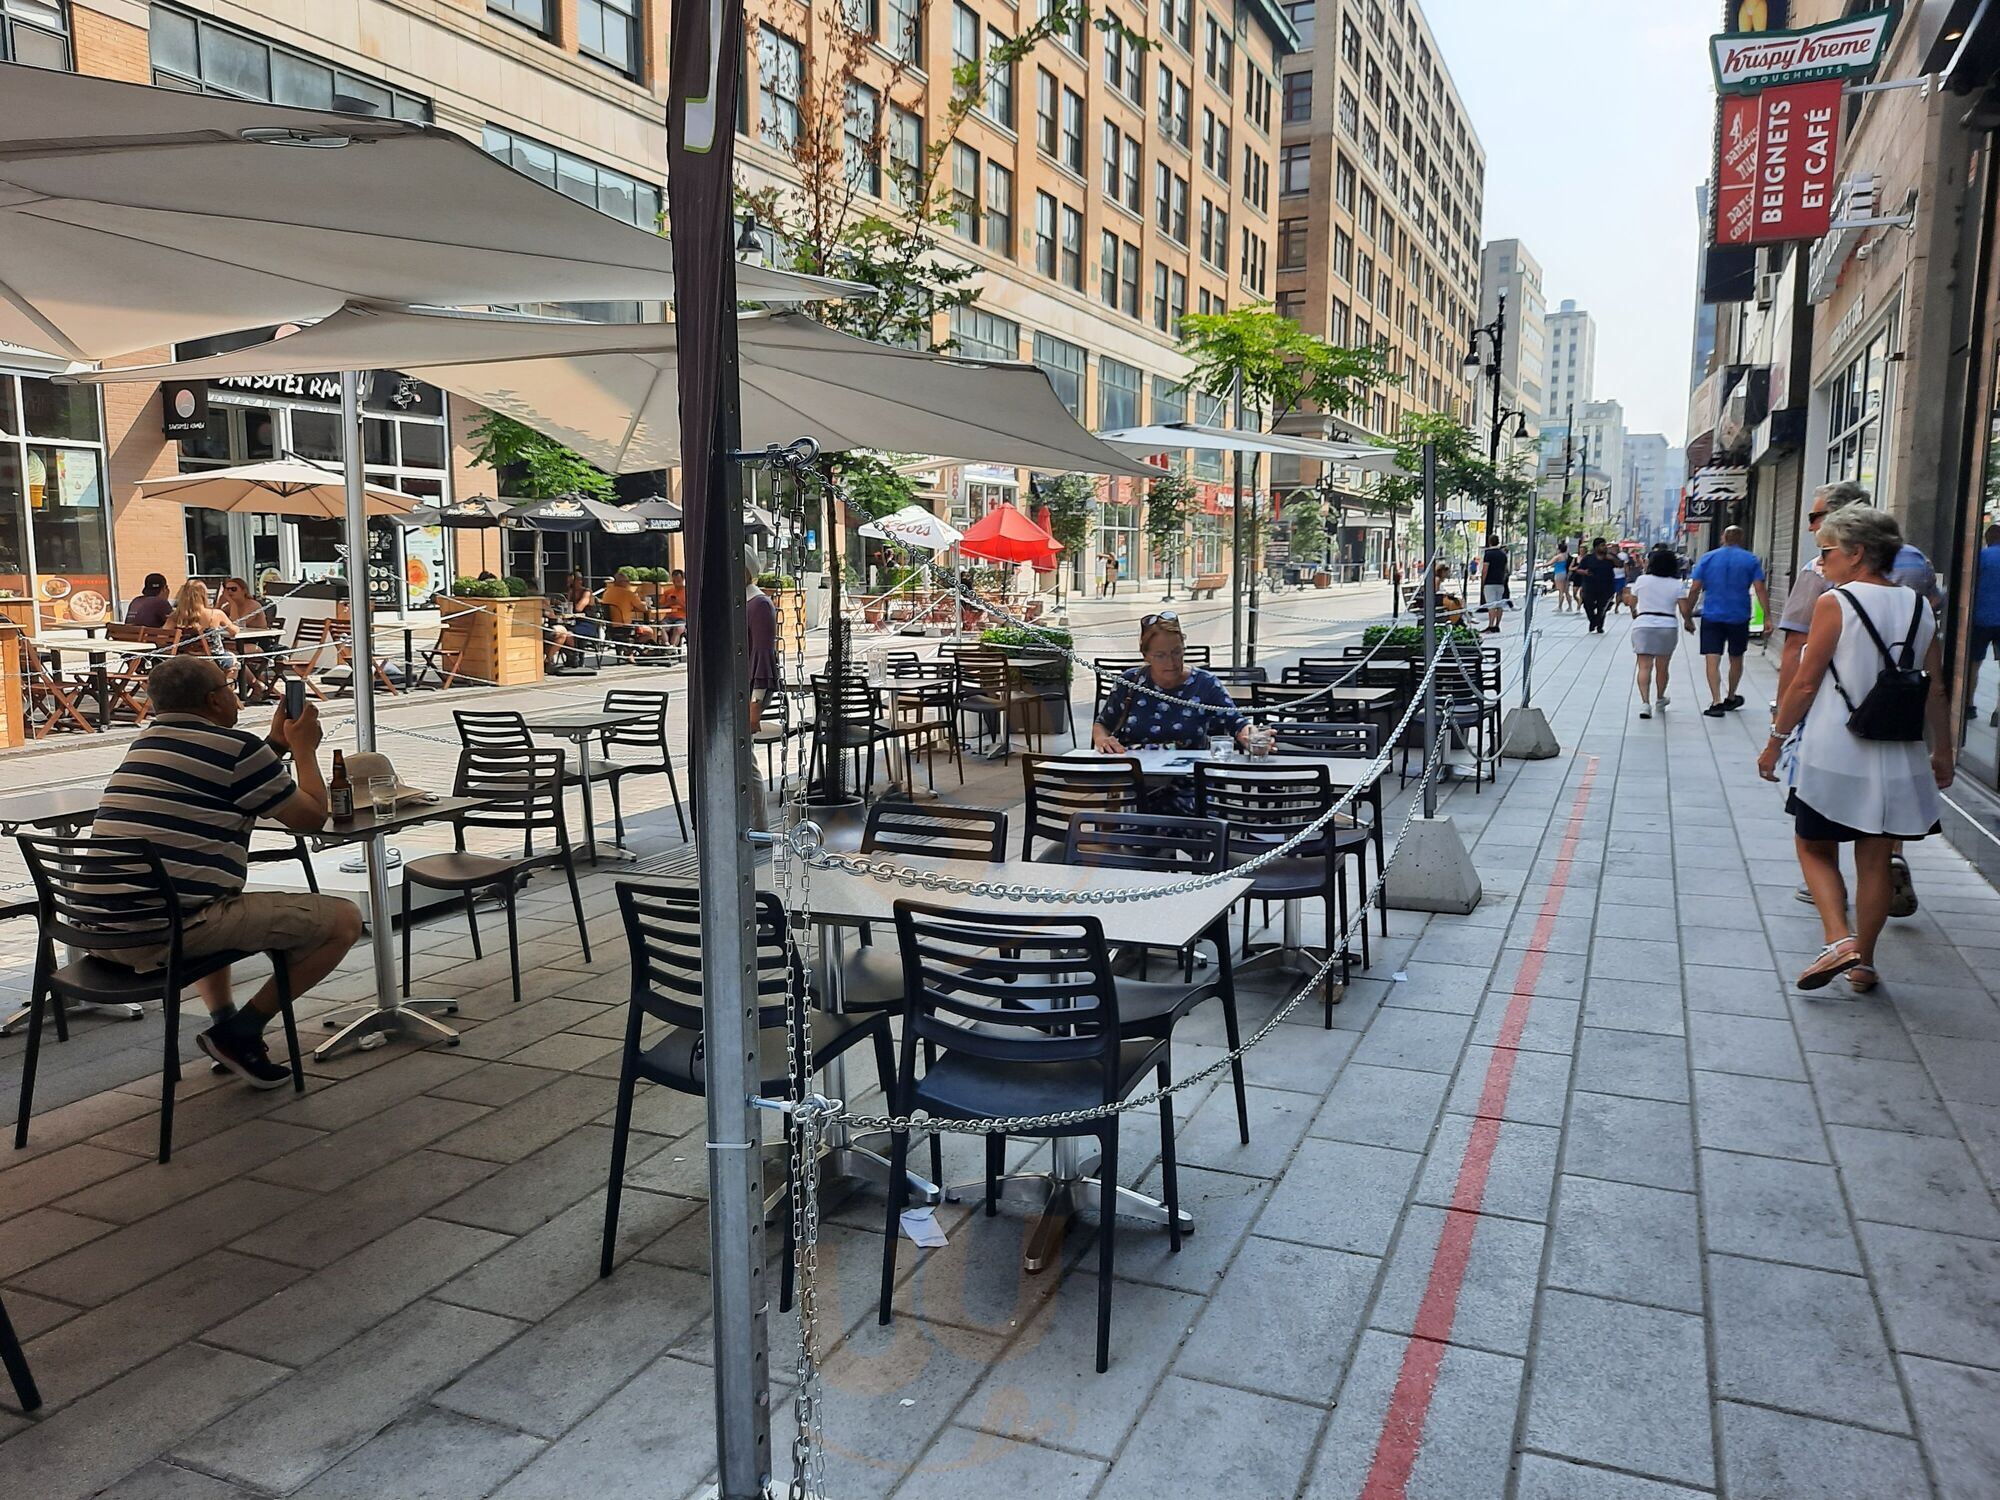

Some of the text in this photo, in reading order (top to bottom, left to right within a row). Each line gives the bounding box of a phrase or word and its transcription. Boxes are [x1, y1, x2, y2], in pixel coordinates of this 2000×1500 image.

[1723, 27, 1871, 74] Krispy Kreme
[1750, 66, 1843, 86] DOUGHNUTS
[1803, 107, 1832, 176] CAFÉ
[1761, 100, 1791, 224] BEIGNETS
[1801, 180, 1825, 209] ET
[650, 519, 681, 528] SAPPORO
